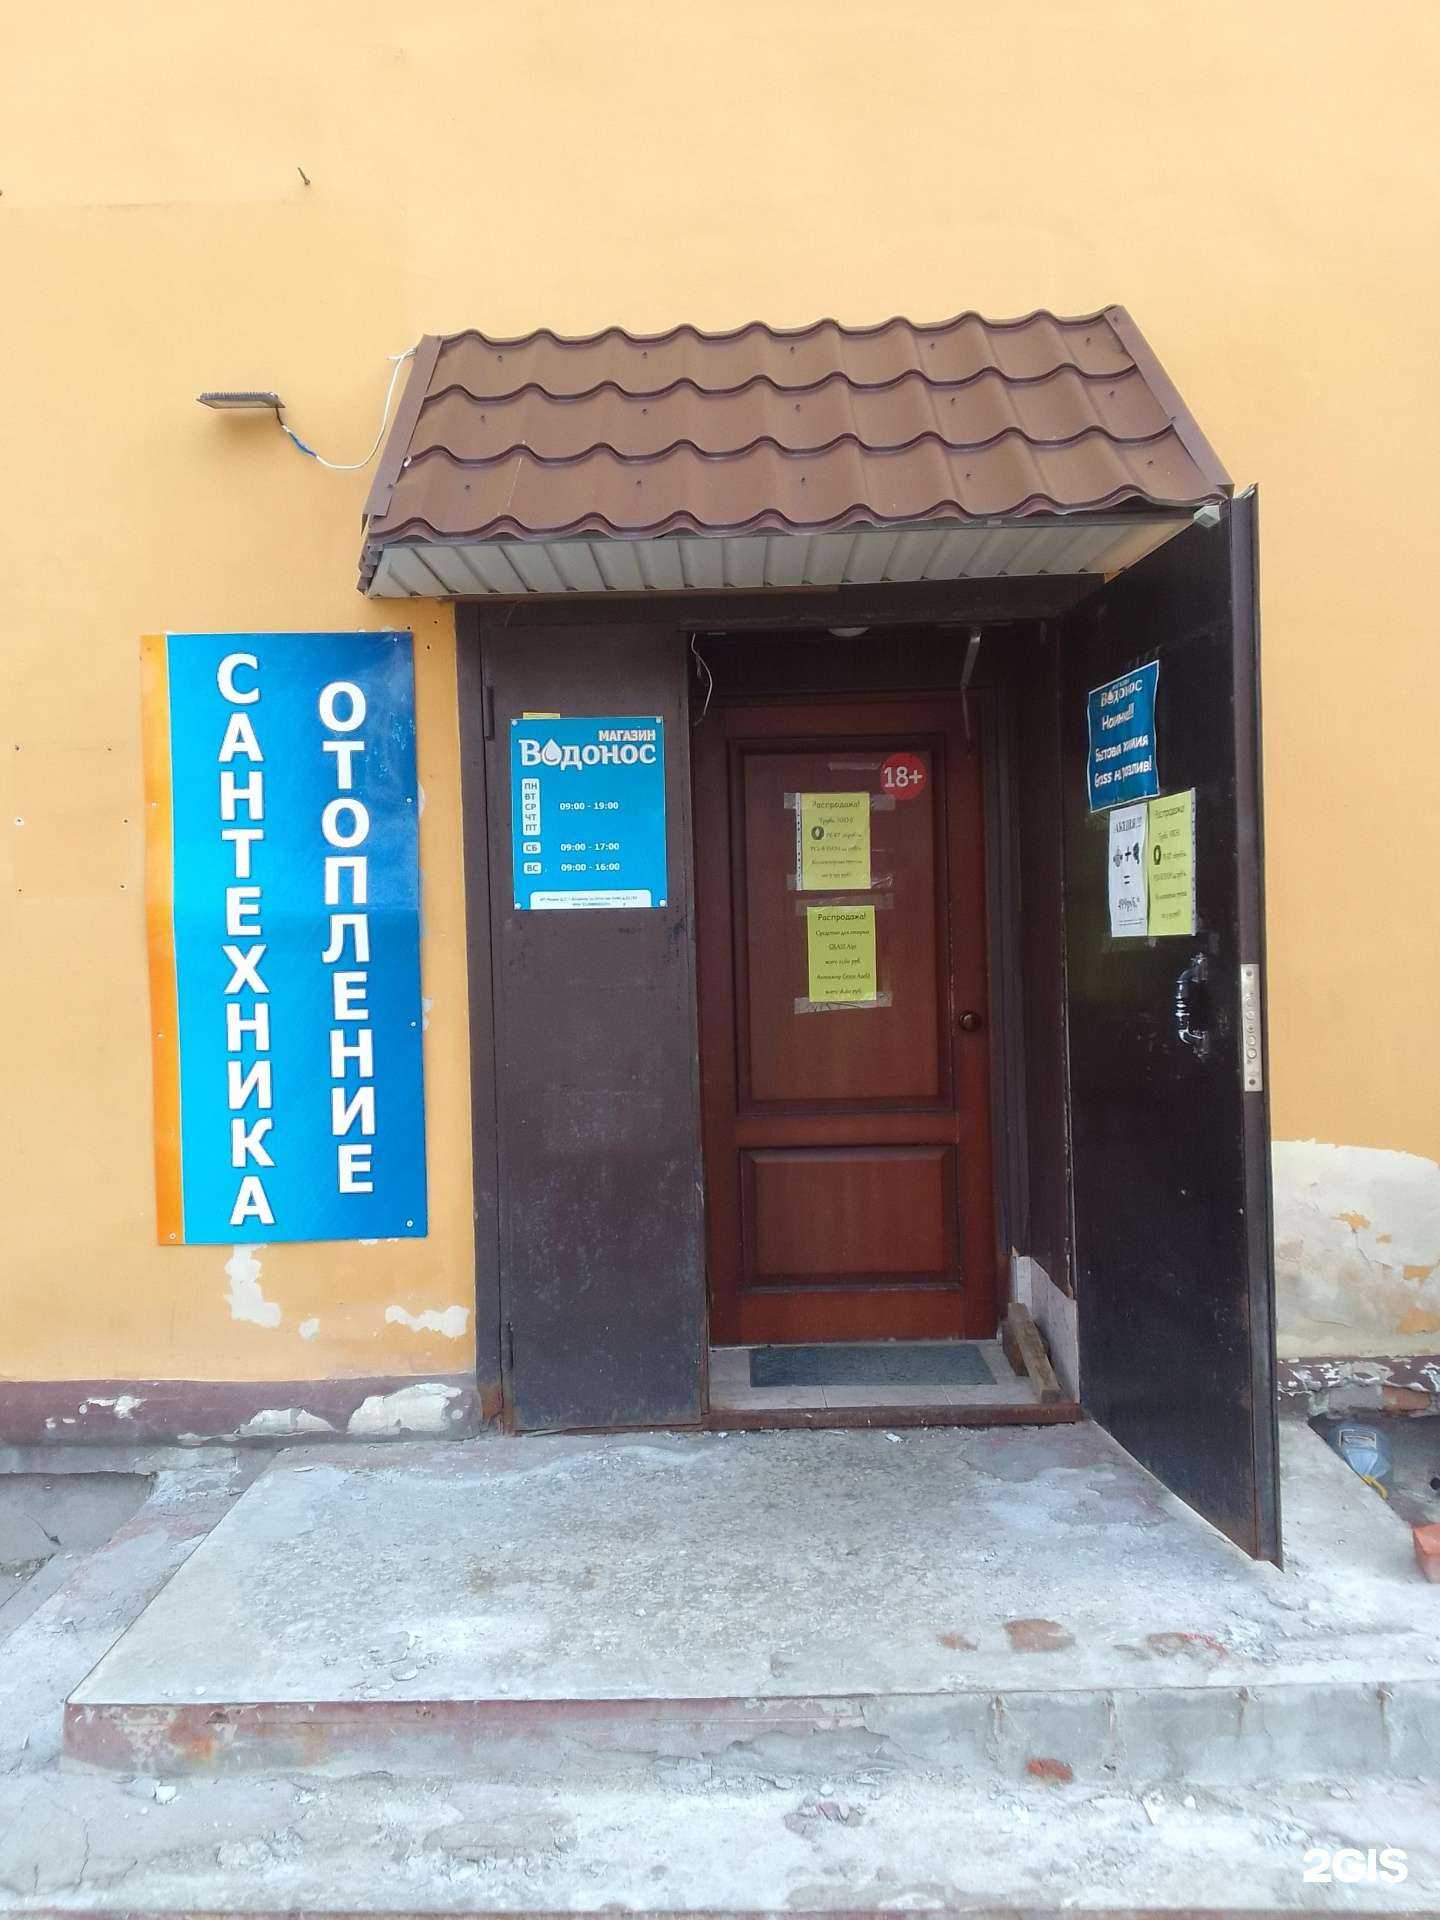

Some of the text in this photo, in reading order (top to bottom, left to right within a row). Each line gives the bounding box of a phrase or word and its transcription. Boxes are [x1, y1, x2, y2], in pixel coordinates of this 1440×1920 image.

[598, 729, 656, 741] МАГАЗИН
[883, 766, 923, 788] 18+
[524, 782, 538, 790] ПН
[524, 803, 537, 811] СР
[559, 802, 585, 810] 09:00
[594, 801, 619, 810] 19:00
[524, 813, 537, 821] ЧТ
[525, 844, 538, 852] СБ
[560, 843, 586, 851] 09:00
[594, 843, 620, 851] 17:00
[526, 864, 539, 872] ВС
[561, 863, 586, 871] 09:00
[595, 863, 620, 871] 16:00
[215, 652, 276, 1226] САНТЕХНИКА
[318, 681, 377, 1195] ОТОПЛЕНИЕ
